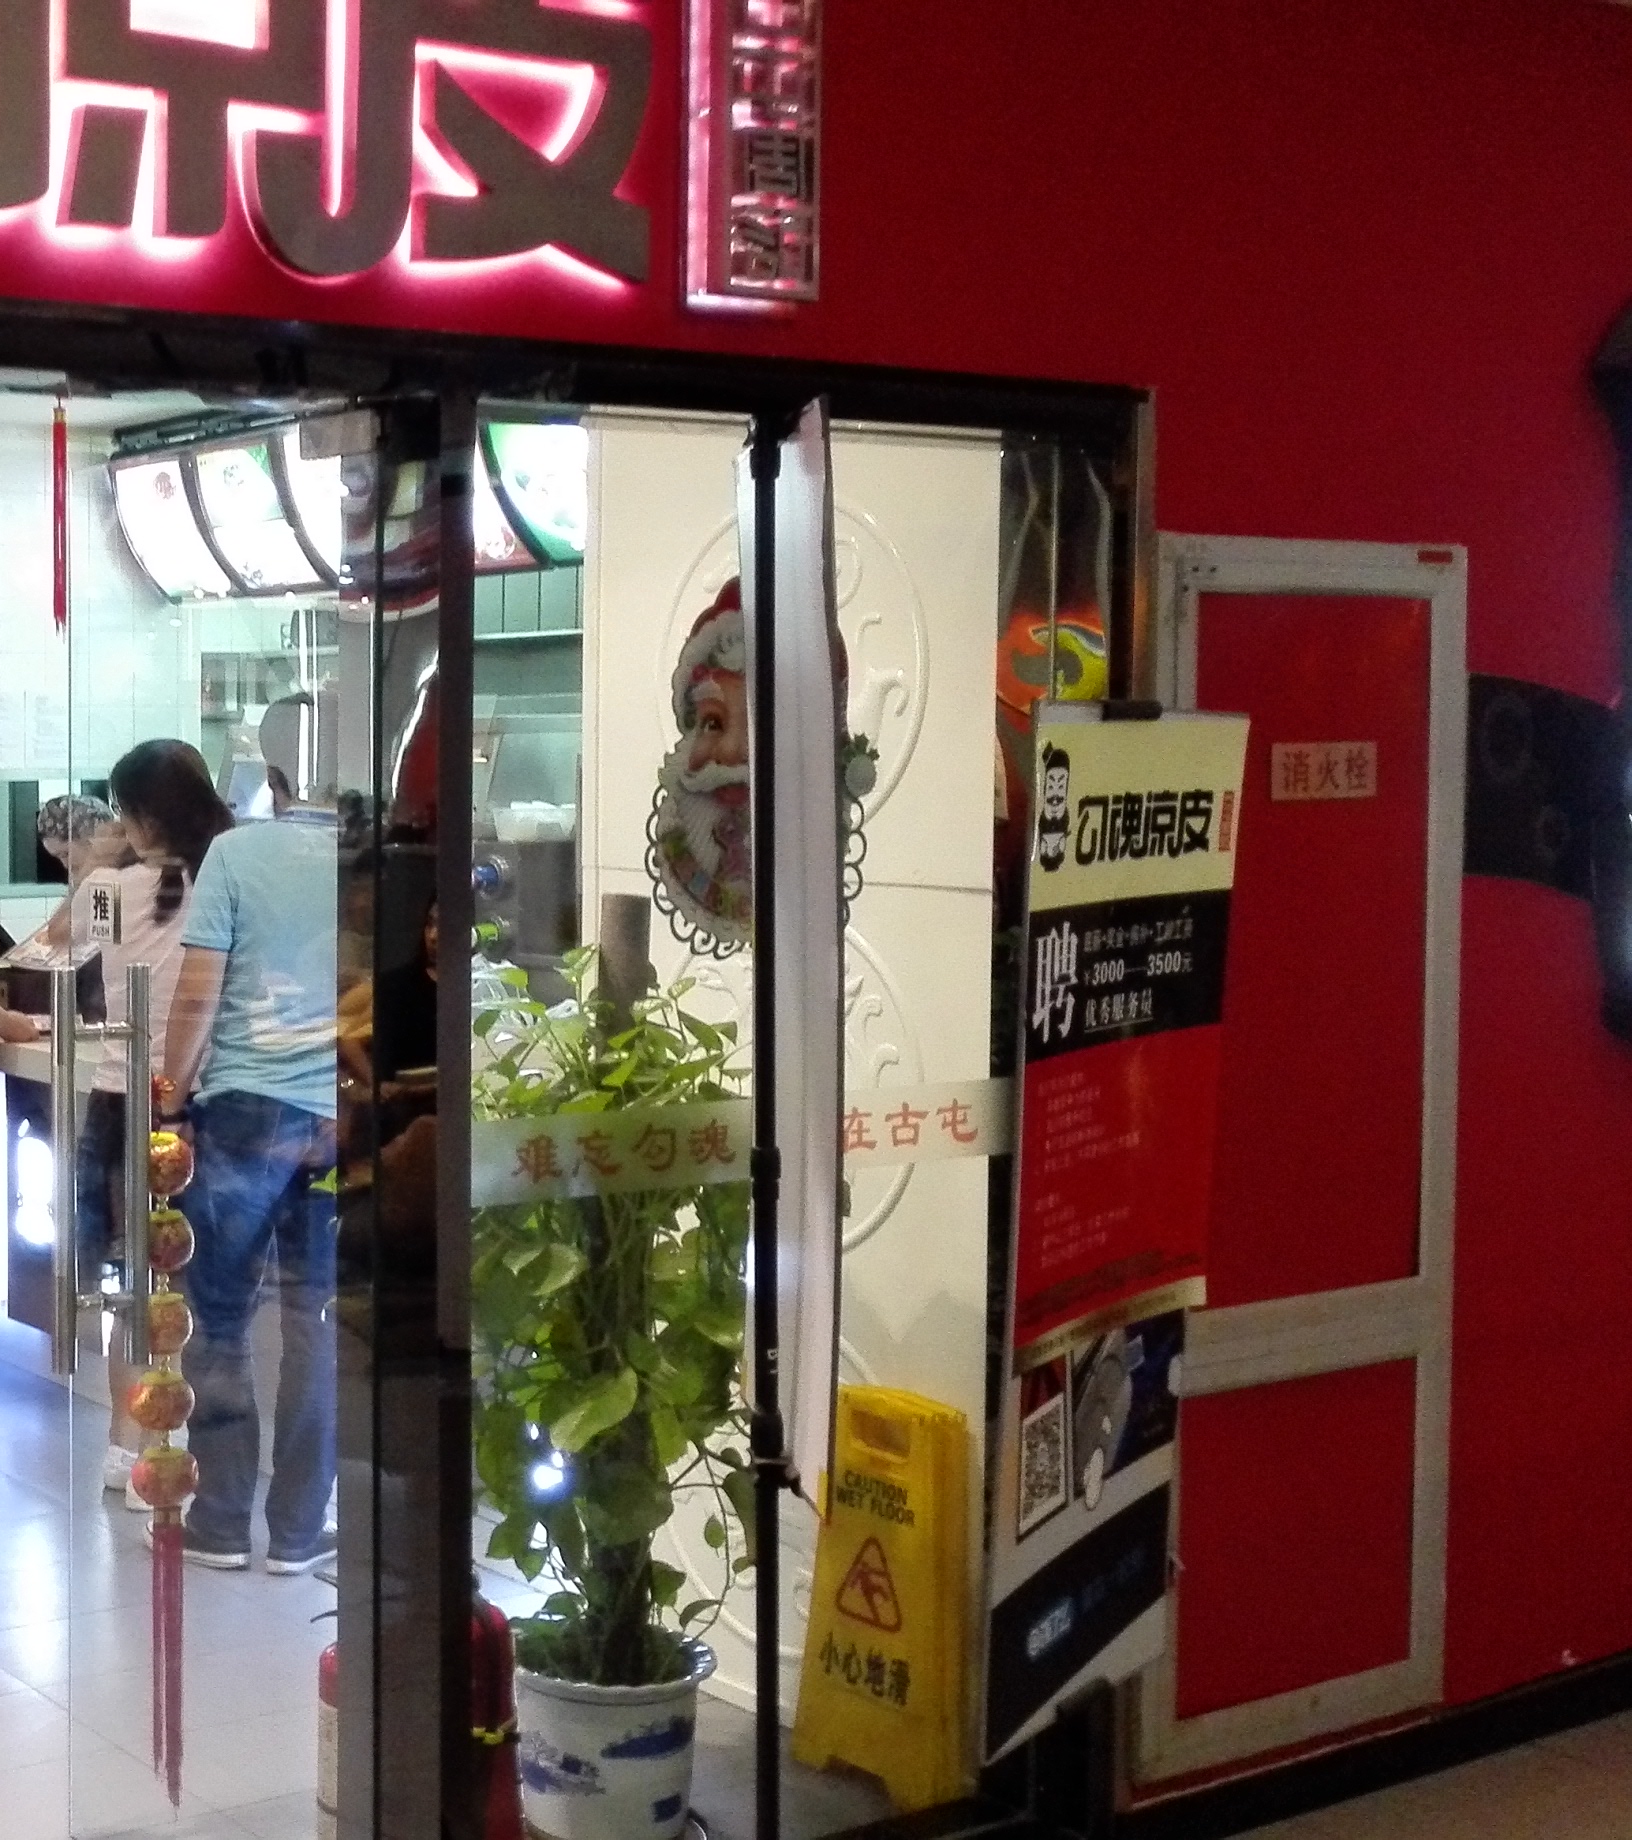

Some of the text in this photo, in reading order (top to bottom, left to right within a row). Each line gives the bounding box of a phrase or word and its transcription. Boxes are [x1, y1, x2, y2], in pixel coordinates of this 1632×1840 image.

[1282, 748, 1368, 793] 消火栓
[93, 888, 109, 920] 推
[91, 924, 109, 937] PUSH
[1032, 921, 1079, 1043] 聘
[843, 1098, 979, 1152] 在古屯
[511, 1118, 736, 1184] 难忘勾魂
[836, 1486, 916, 1526] WET FLOOR
[844, 1469, 909, 1506] CAUTION
[819, 1631, 911, 1706] 小心地滑
